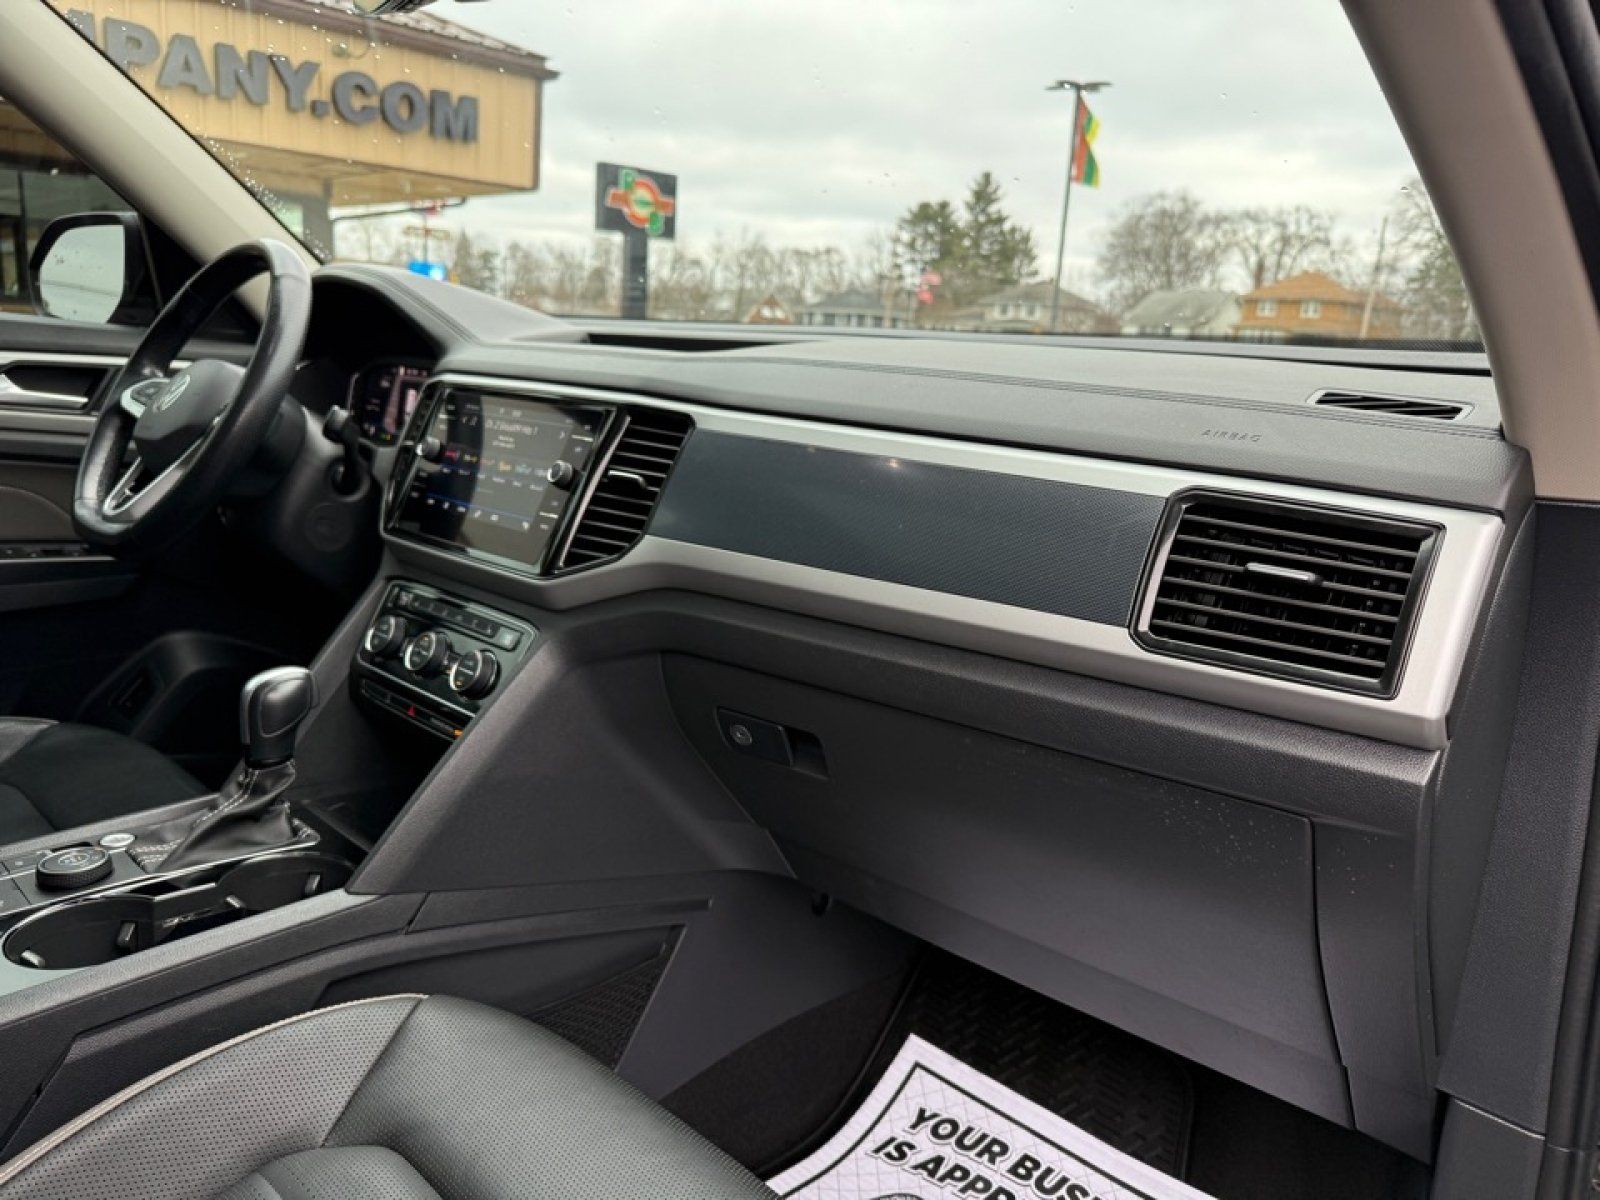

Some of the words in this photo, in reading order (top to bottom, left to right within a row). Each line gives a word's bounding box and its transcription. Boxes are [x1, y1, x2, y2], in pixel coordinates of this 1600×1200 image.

[1200, 428, 1262, 443] AIRBAG
[871, 1136, 917, 1161] IS
[909, 1107, 1010, 1166] YOUR
[1006, 1152, 1101, 1200] BUS
